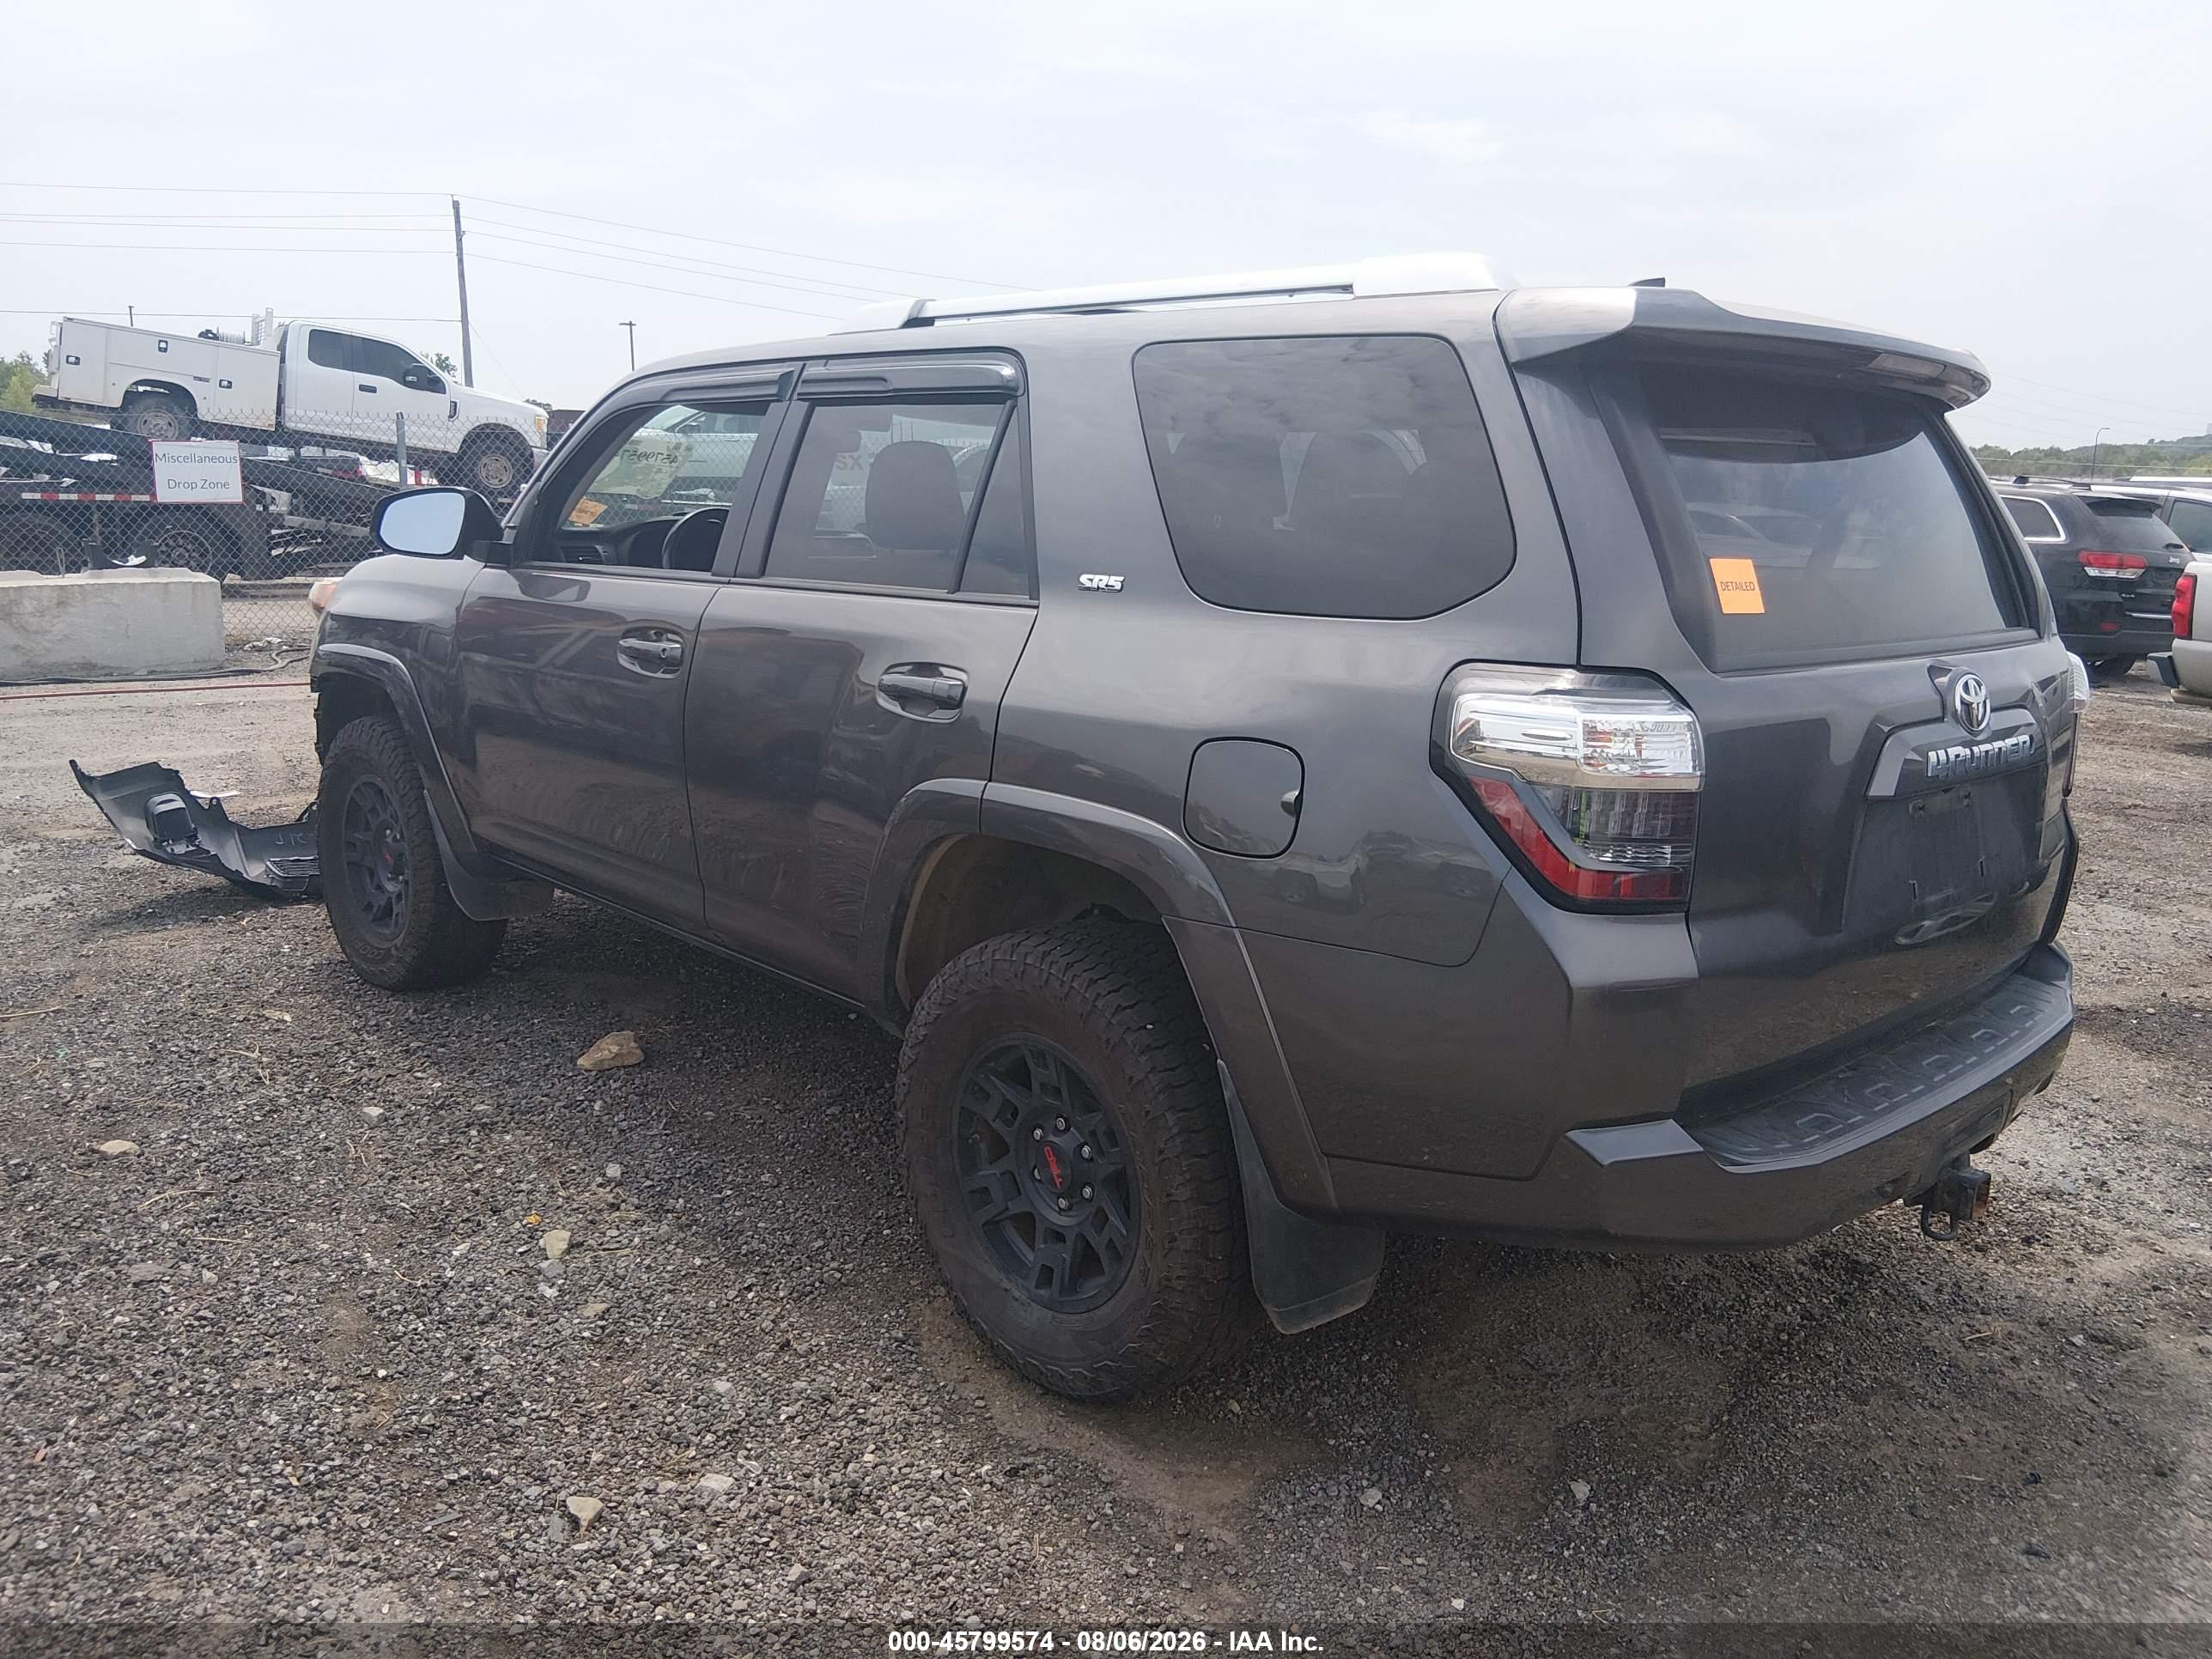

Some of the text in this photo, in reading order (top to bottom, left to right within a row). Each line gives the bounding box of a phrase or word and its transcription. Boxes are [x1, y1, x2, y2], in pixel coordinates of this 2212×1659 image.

[155, 453, 238, 464] Miscellaneous
[167, 478, 230, 491] Drop Zone
[1079, 574, 1125, 592] SR5
[1720, 580, 1756, 592] DETAILED
